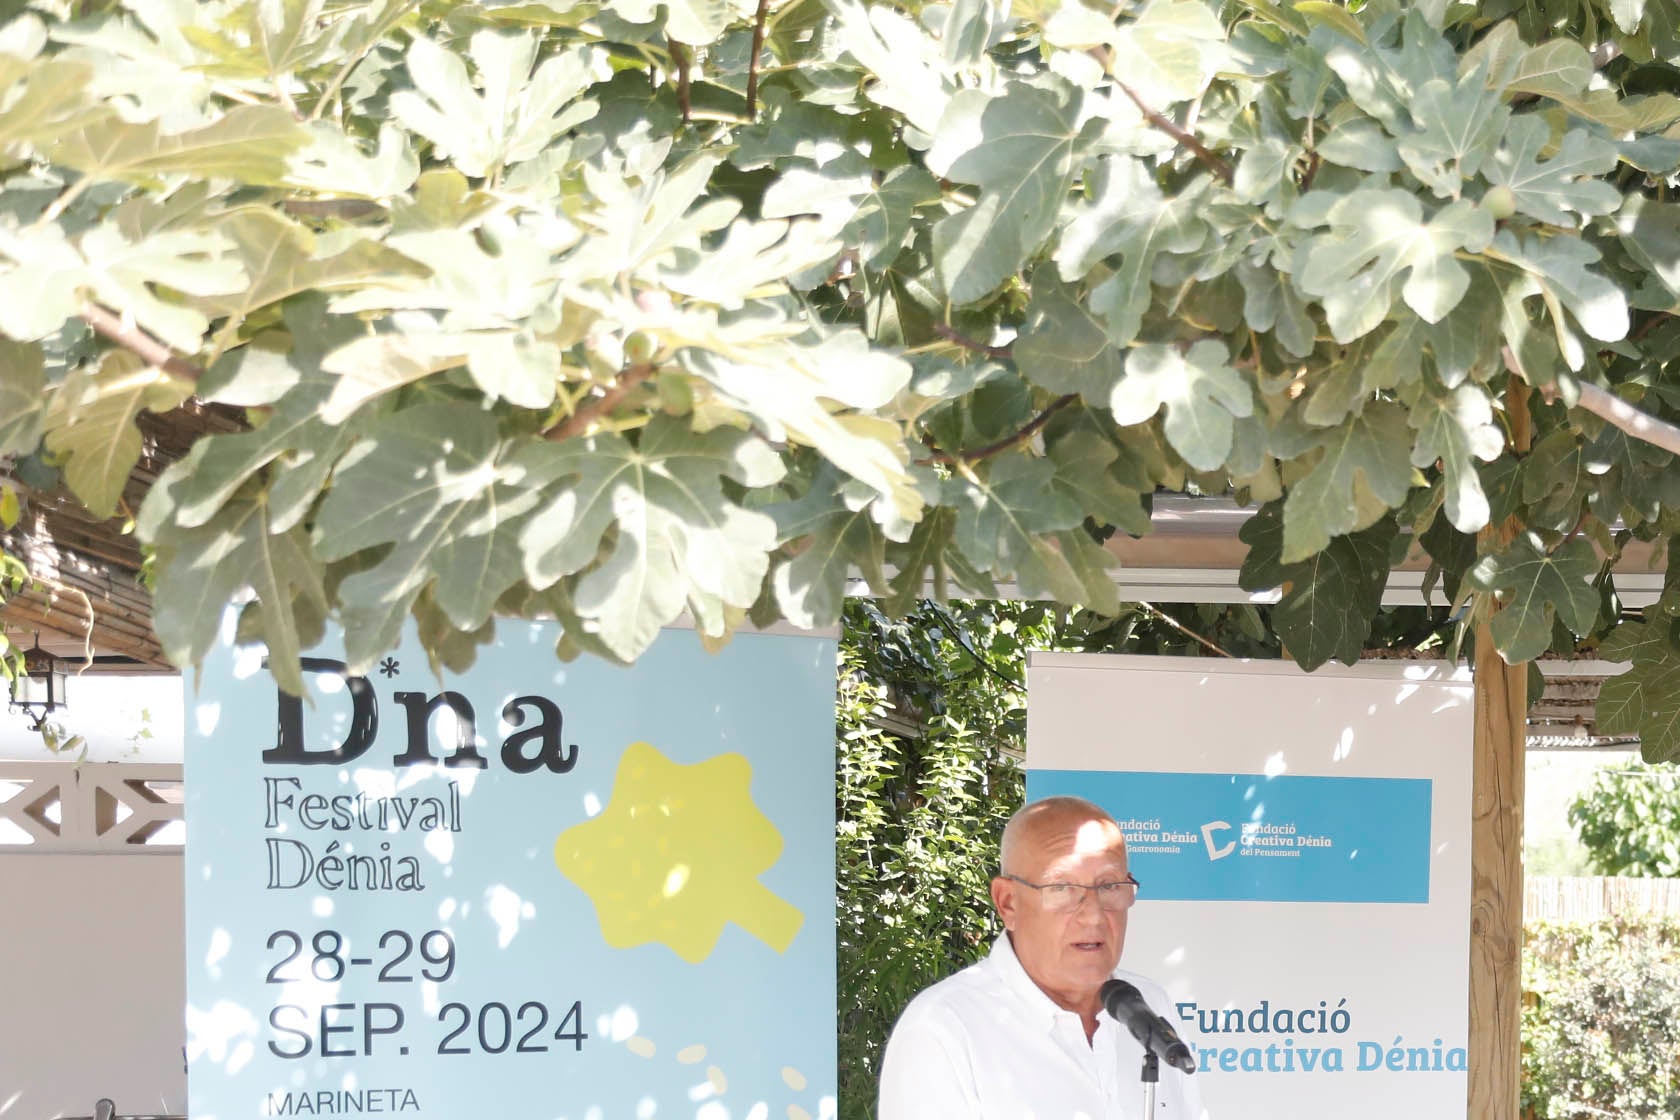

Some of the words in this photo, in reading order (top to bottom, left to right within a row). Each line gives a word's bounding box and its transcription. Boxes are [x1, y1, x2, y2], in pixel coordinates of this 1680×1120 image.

[264, 776, 462, 832] Festival
[1162, 830, 1197, 843] Dénia
[1240, 848, 1252, 856] del
[1254, 848, 1300, 857] Pensament
[1297, 834, 1332, 847] Dénia
[265, 838, 425, 891] Dénia
[266, 930, 456, 984] 28-29
[267, 1003, 409, 1059] SEP.
[437, 1001, 588, 1054] 2024
[1176, 998, 1350, 1034] Fundació
[1192, 1038, 1344, 1073] reativa
[1356, 1036, 1468, 1073] Dénia
[267, 1088, 420, 1116] MARINETA
